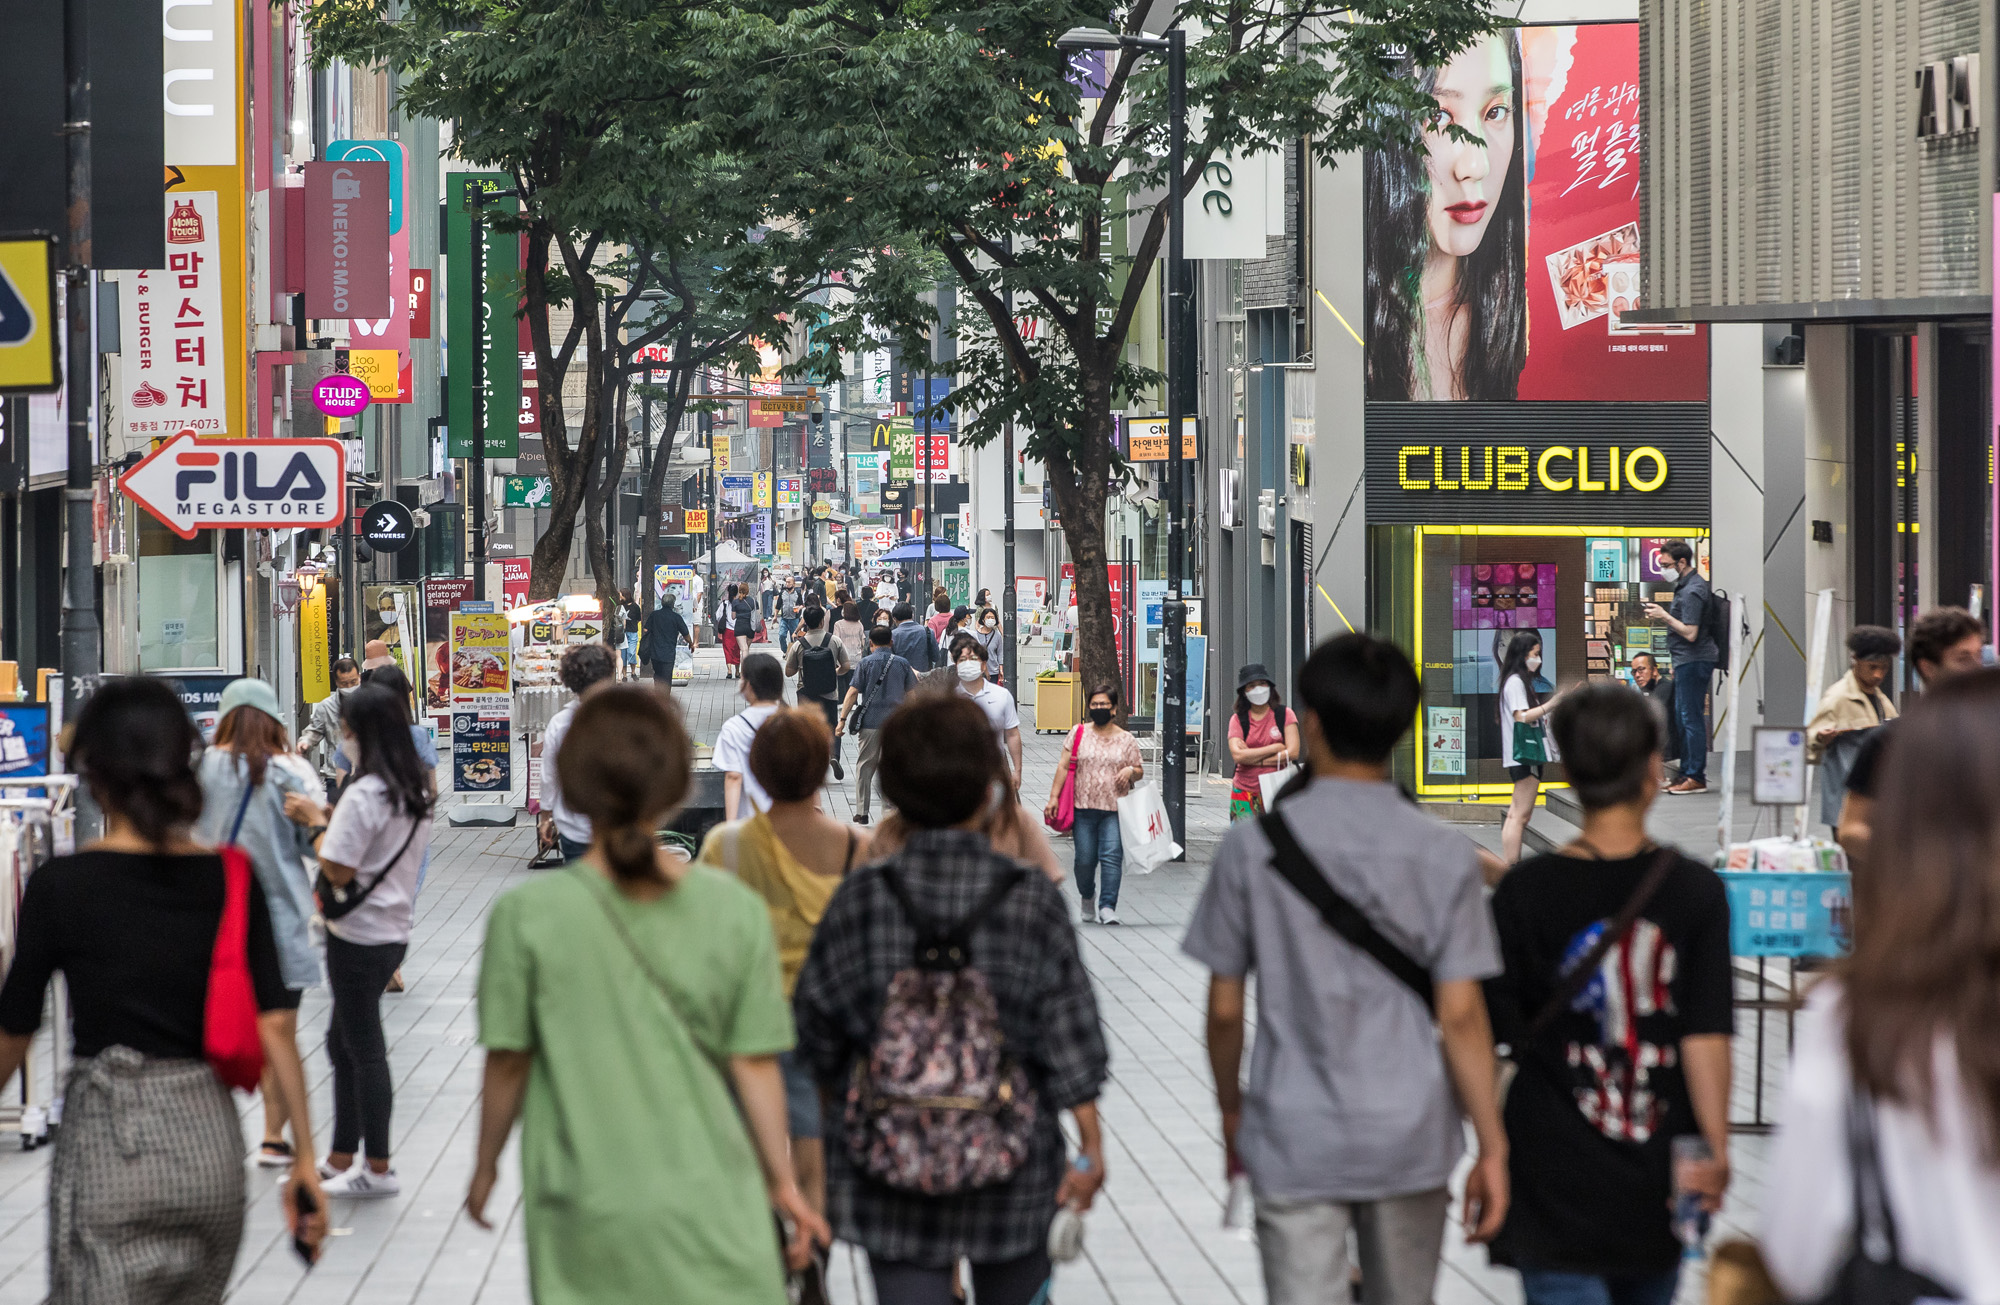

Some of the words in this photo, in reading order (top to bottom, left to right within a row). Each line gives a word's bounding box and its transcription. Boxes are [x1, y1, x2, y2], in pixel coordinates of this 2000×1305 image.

[1565, 86, 1603, 120] 영롱
[171, 227, 199, 236] TOUCH
[138, 285, 148, 295] &
[139, 302, 151, 369] BURGER
[169, 252, 207, 408] 맘스터치
[356, 356, 374, 364] too
[637, 347, 668, 362] ABC
[356, 375, 371, 383] for
[319, 387, 362, 398] ETUDE
[369, 384, 393, 393] hool
[765, 384, 781, 395] 2F
[130, 422, 158, 432] 명동점
[163, 419, 219, 430] 777-6073
[1132, 438, 1193, 450] 차앤박피과
[719, 455, 728, 467] $
[857, 456, 878, 466] 나은
[1399, 446, 1529, 490] CLUB
[1537, 446, 1668, 491] CLIO
[176, 452, 326, 501] FILA
[780, 481, 787, 490] $
[791, 481, 798, 490] 元
[780, 493, 787, 501] €
[791, 493, 798, 501] ¥
[177, 503, 325, 515] MEGASTORE
[687, 512, 706, 521] ABC
[875, 531, 892, 547] 약
[493, 542, 513, 550] A'pieu
[1599, 561, 1615, 569] BEST
[502, 572, 529, 580] JAMA
[1599, 570, 1614, 578] ITEM
[427, 583, 466, 591] strawberry
[427, 591, 449, 599] gelato
[451, 590, 461, 599] pie
[535, 626, 550, 637] 5F
[315, 655, 323, 683] school
[177, 693, 200, 703] IDS
[203, 693, 223, 703] MA
[472, 742, 509, 753] 무한리필
[1148, 809, 1163, 840] H&M
